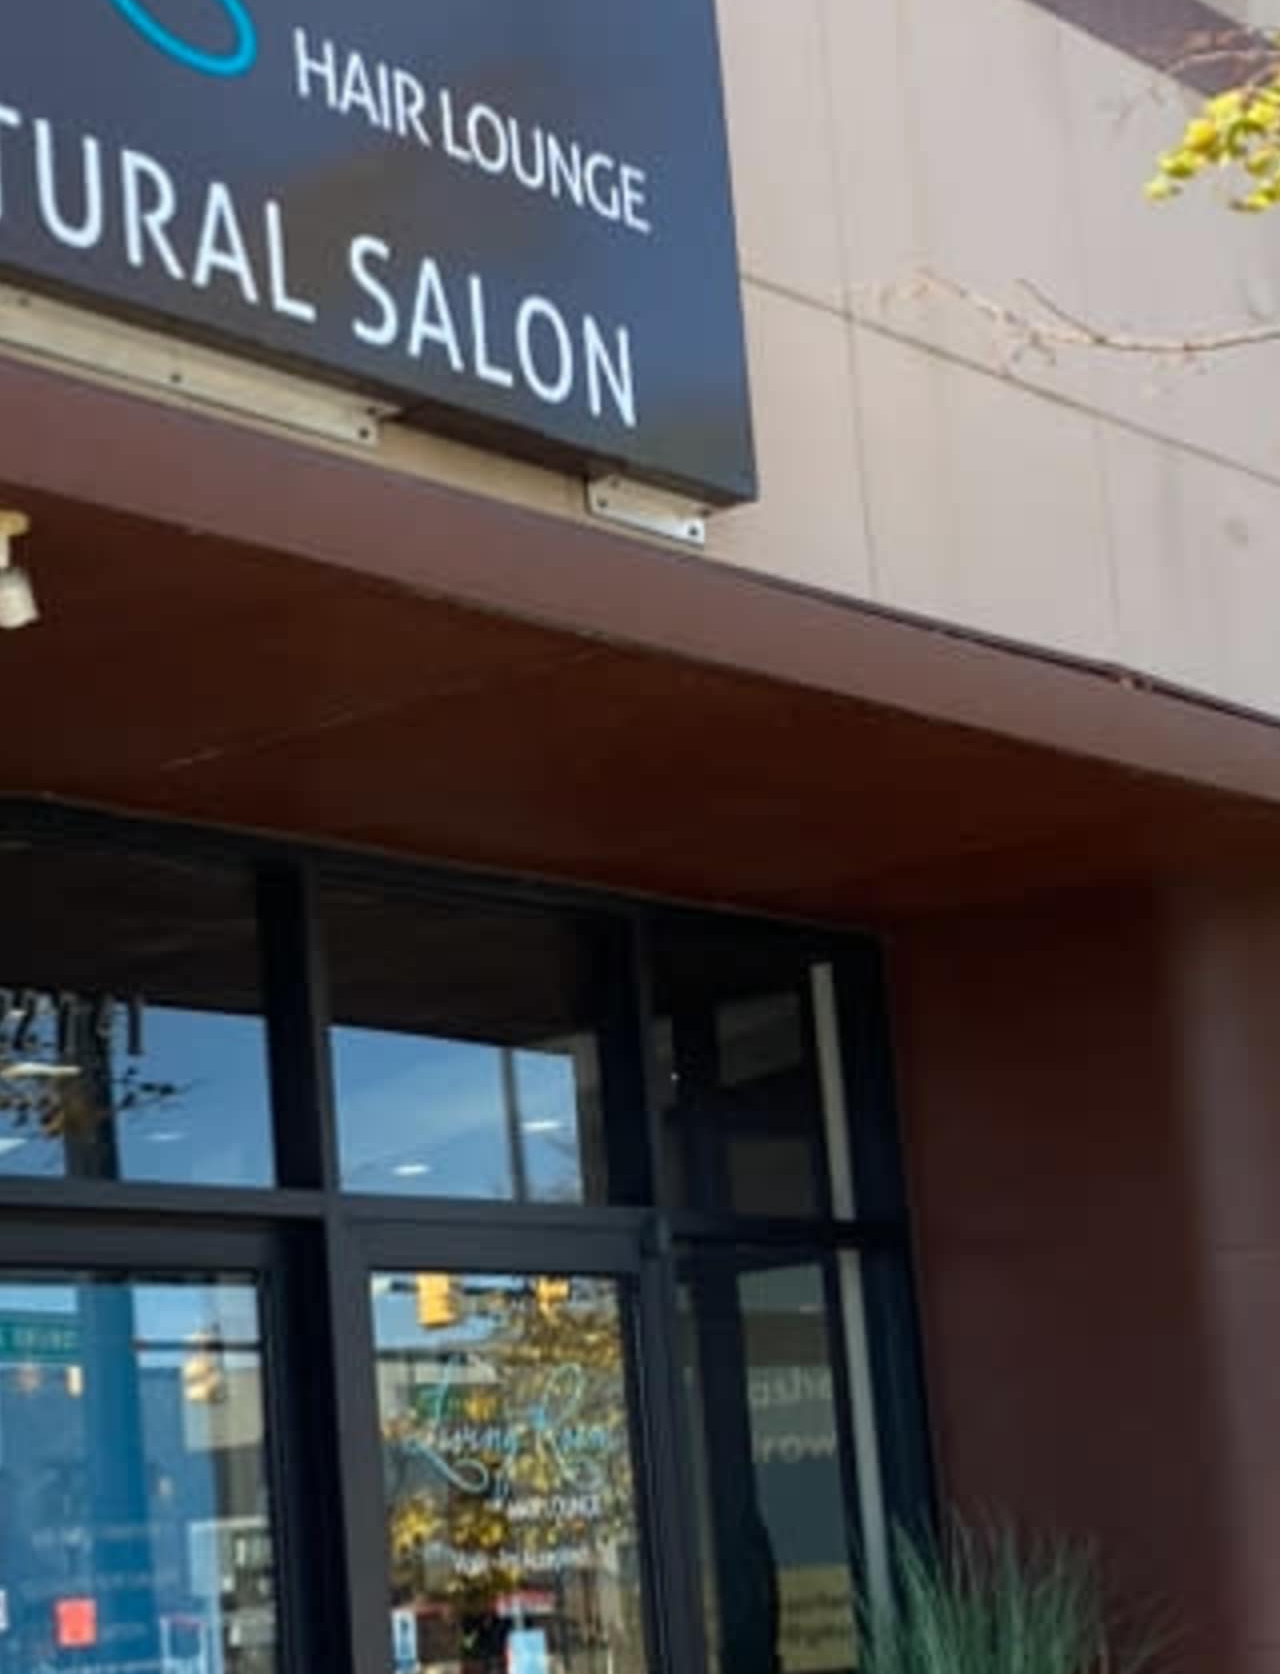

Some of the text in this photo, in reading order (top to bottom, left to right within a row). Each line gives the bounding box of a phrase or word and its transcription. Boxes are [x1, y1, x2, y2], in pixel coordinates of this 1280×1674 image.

[294, 27, 652, 234] HAIR LOUNGE
[349, 234, 637, 428] SALON
